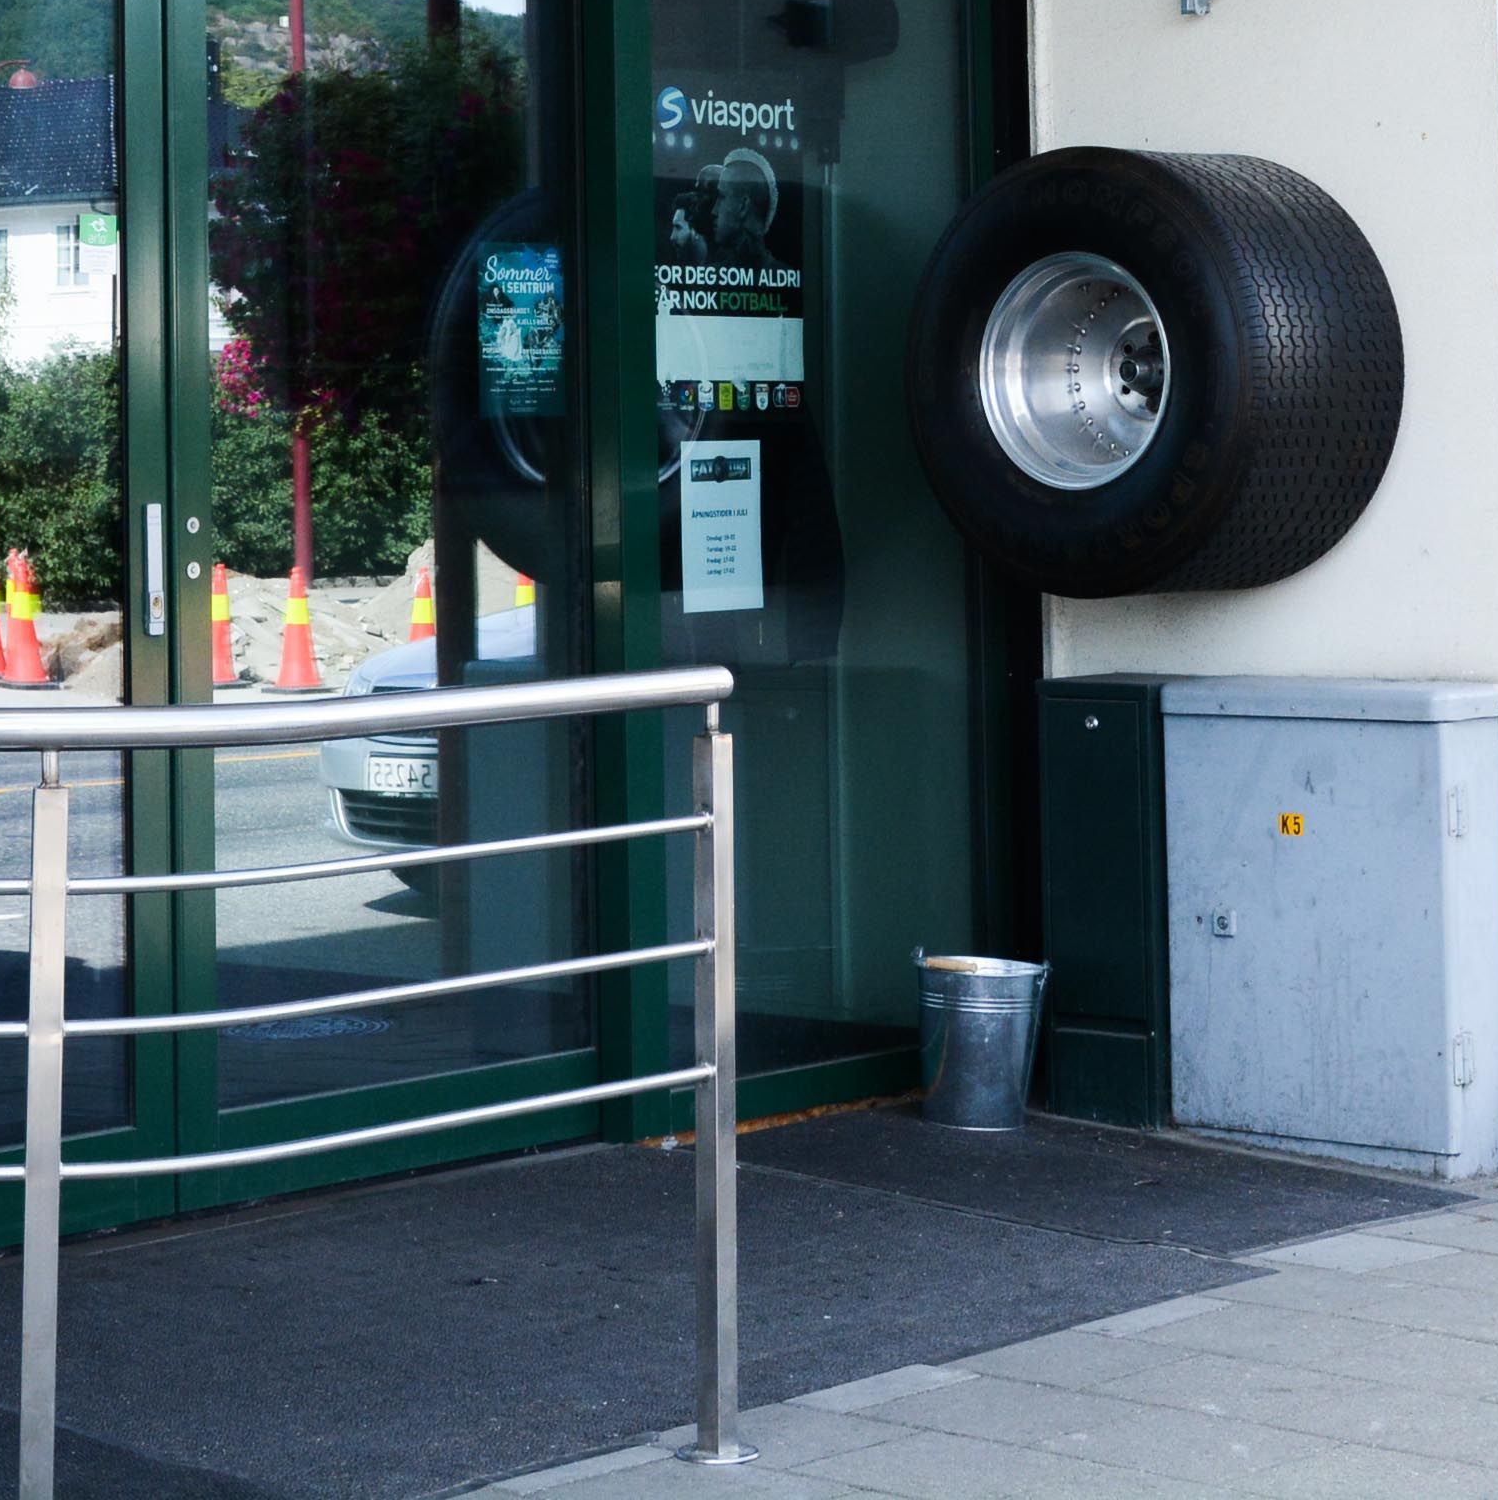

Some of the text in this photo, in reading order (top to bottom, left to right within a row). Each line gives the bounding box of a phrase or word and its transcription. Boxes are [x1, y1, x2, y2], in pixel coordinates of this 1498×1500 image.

[691, 90, 796, 135] viasport
[485, 253, 553, 283] Sommer
[654, 265, 800, 288] OR DEG SOM ALDRI
[507, 282, 555, 294] SENTRUM
[655, 285, 681, 309] ÅR
[683, 290, 717, 310] NOK
